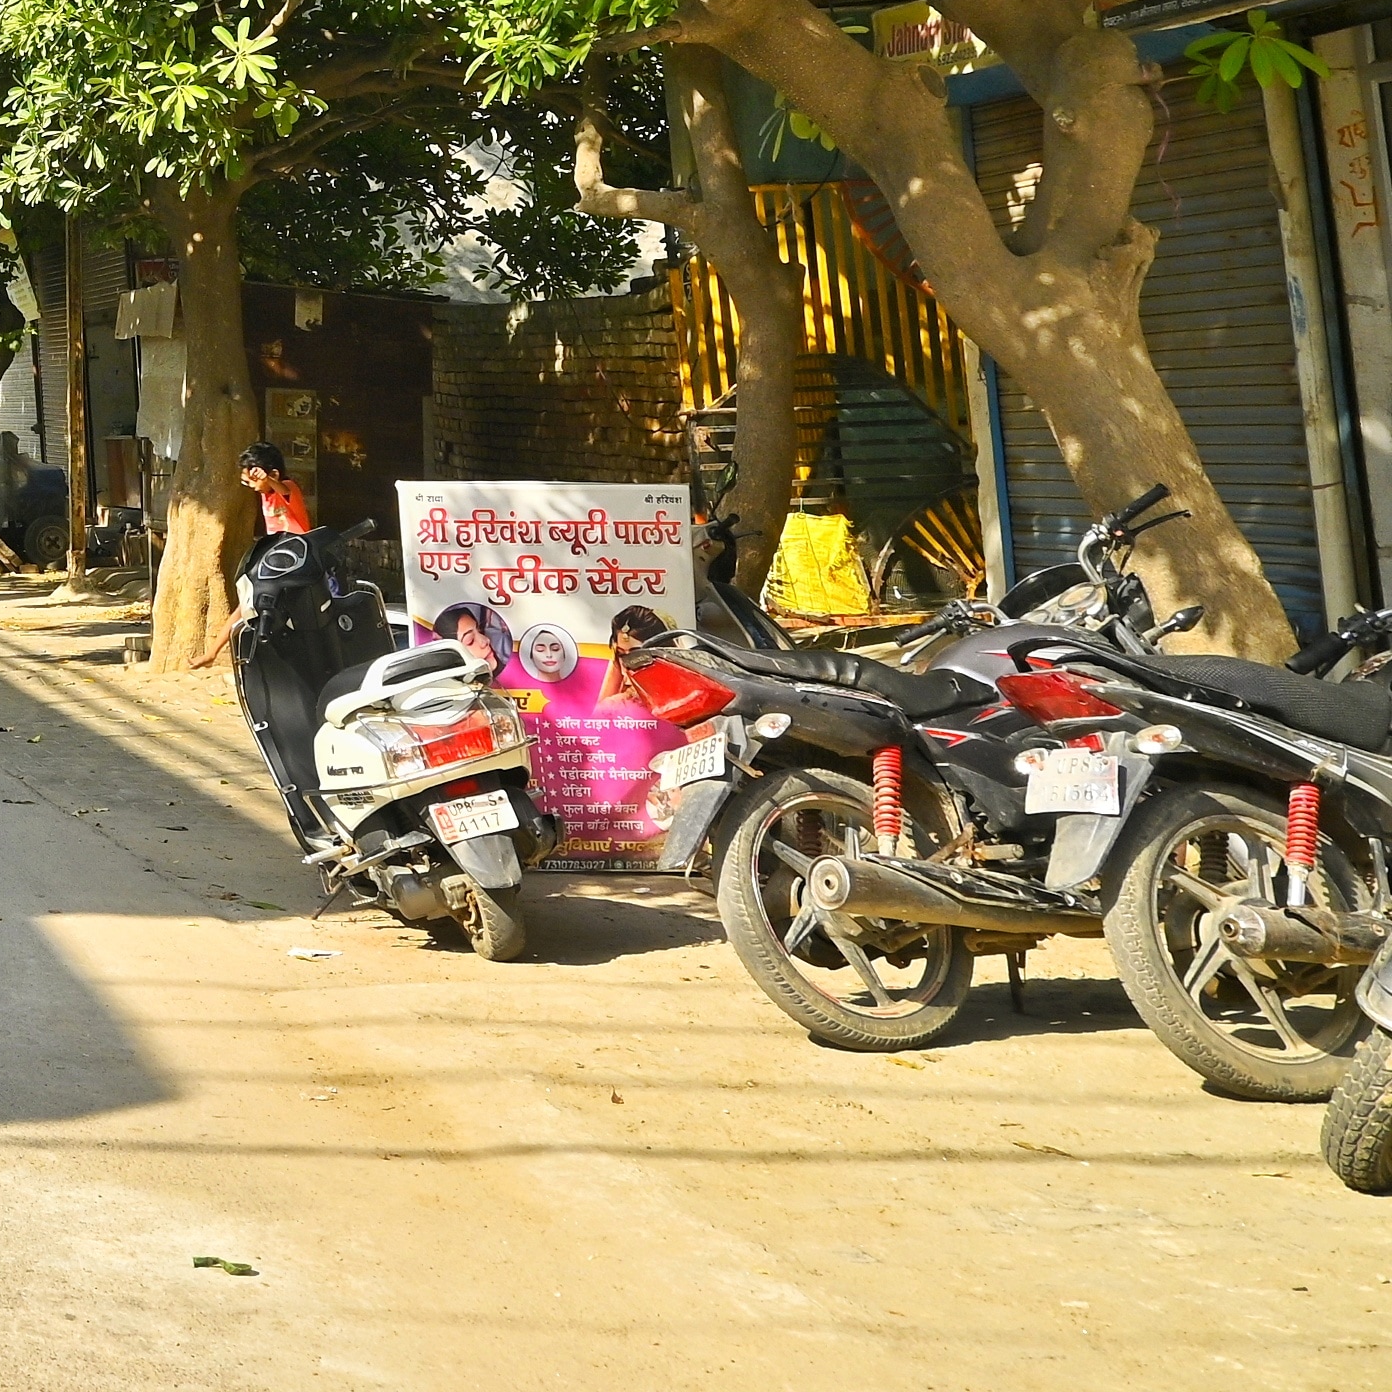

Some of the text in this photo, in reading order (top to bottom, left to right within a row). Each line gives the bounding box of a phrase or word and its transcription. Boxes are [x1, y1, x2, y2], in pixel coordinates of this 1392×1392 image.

[417, 507, 682, 556] श्री हरिवंश ब्यूटी पार्लर
[418, 552, 471, 581] एण्ड
[480, 555, 666, 606] बुटीक सेंटर
[555, 715, 658, 731] ऑल टाइप फेशियल
[555, 731, 601, 747] हेयर कट
[674, 755, 716, 785] H9603
[563, 803, 584, 817] फुल
[458, 812, 501, 835] 4117
[564, 820, 584, 834] फुल
